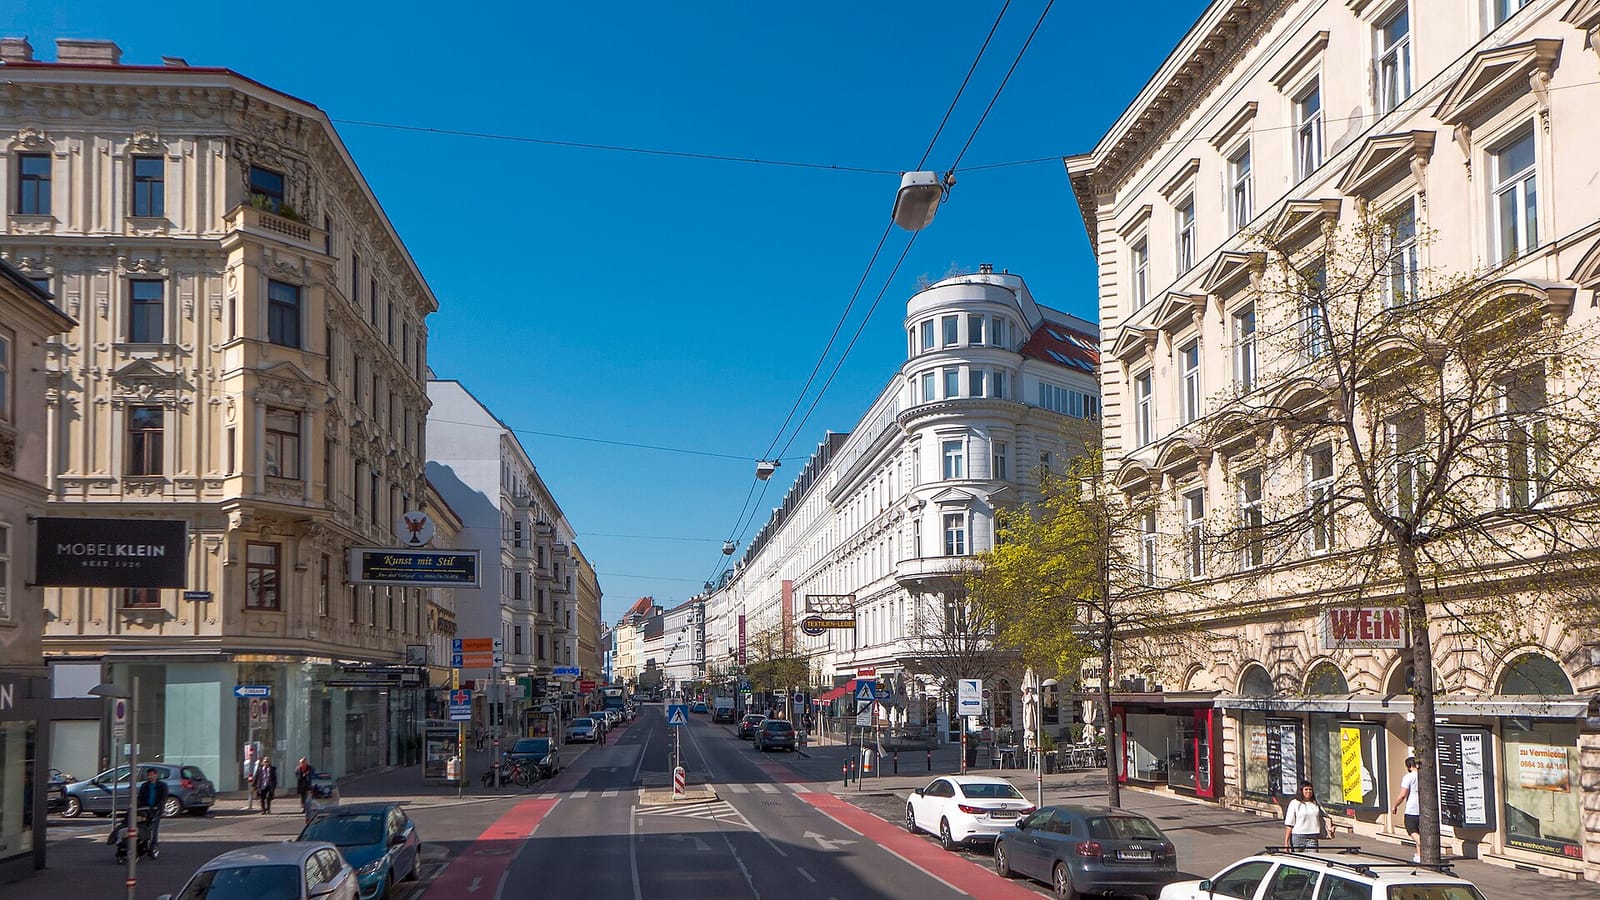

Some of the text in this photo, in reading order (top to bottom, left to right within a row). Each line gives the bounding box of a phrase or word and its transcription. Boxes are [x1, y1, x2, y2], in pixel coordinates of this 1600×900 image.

[384, 555, 456, 567] Kunst mit Stil
[1529, 748, 1566, 759] Vermieten
